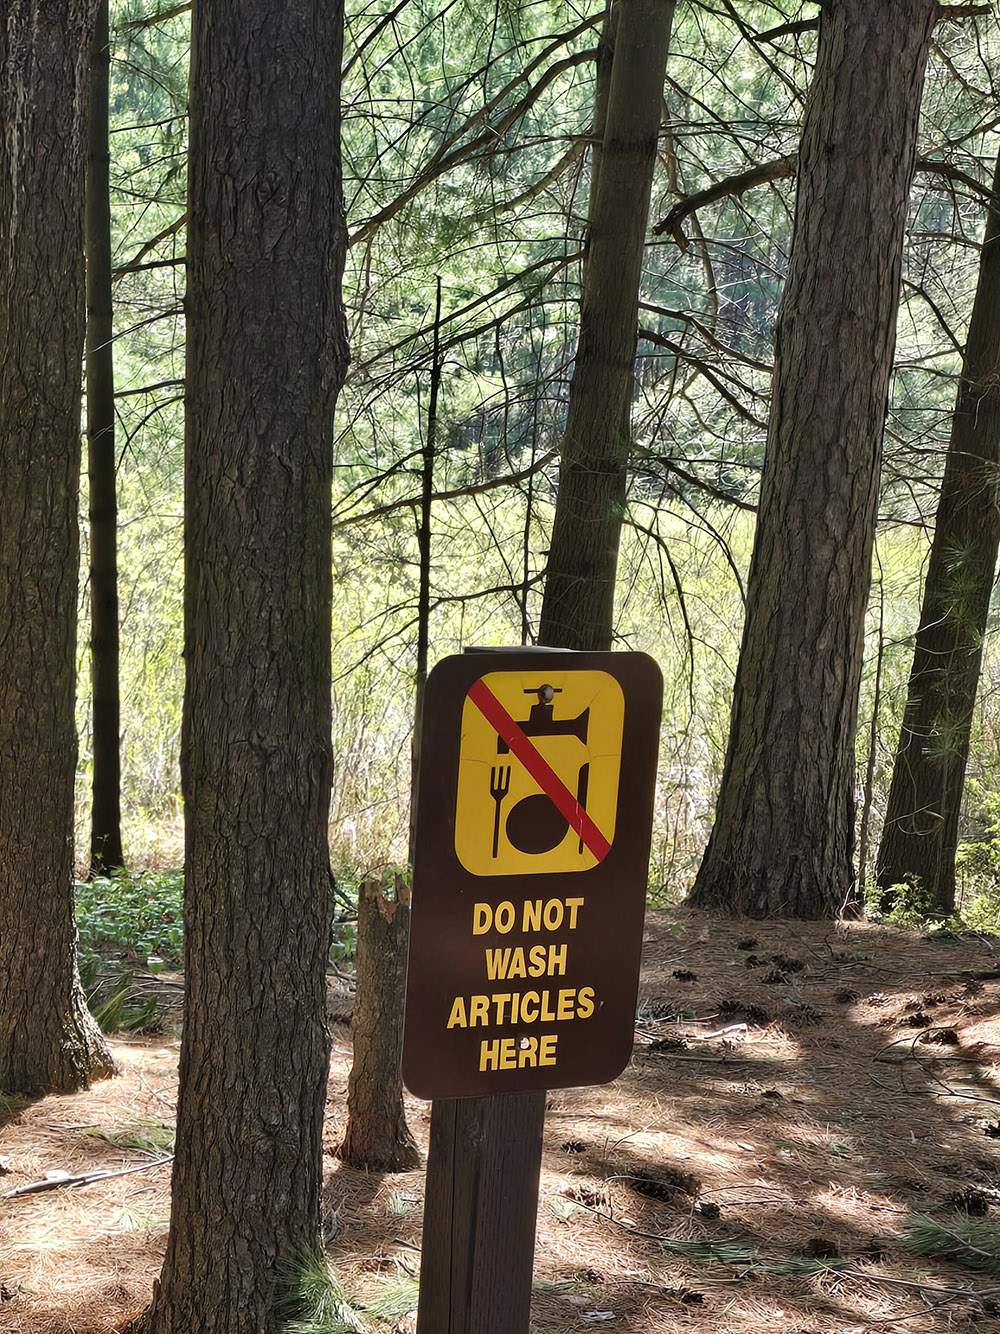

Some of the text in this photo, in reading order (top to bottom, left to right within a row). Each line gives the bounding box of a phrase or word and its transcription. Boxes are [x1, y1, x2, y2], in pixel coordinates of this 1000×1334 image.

[472, 897, 585, 936] DO NOT
[485, 944, 568, 981] WASH
[446, 986, 596, 1029] ARTICLES
[479, 1034, 558, 1072] HERE
